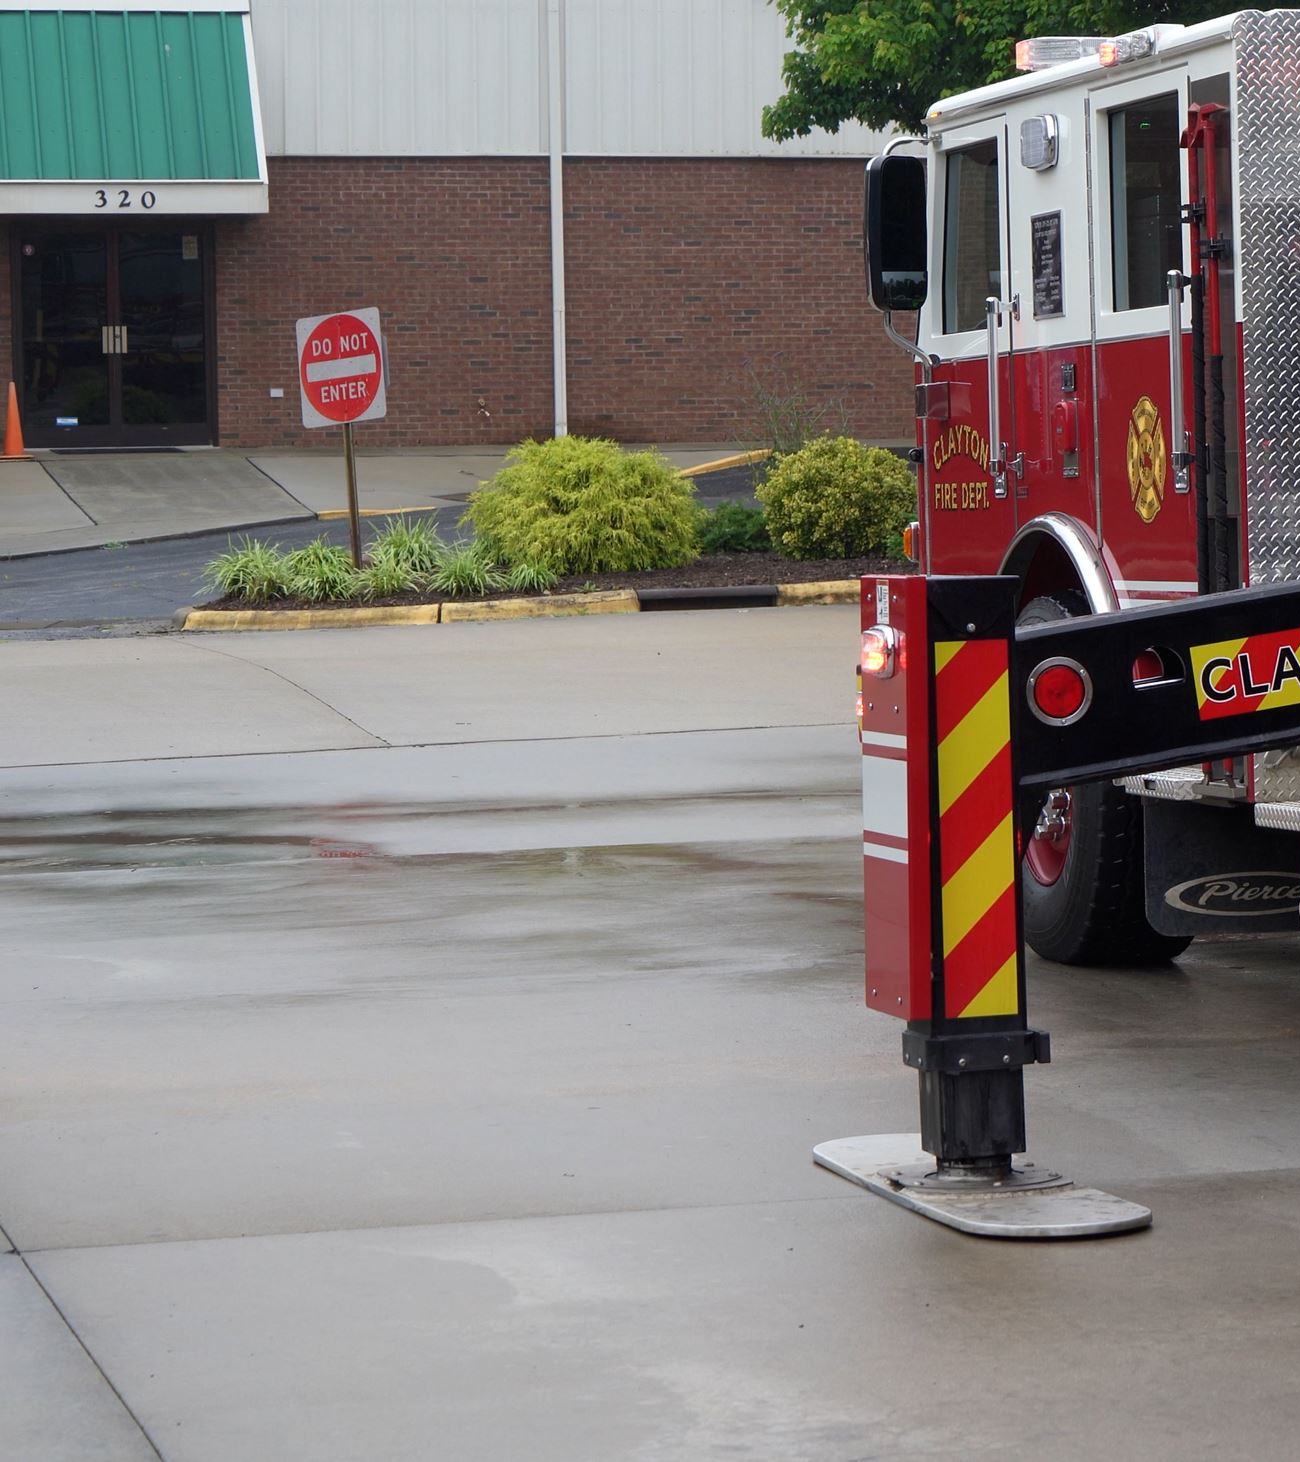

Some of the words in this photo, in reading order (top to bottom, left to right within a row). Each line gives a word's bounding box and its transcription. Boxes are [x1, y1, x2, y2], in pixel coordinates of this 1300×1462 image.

[95, 190, 156, 209] 320
[312, 338, 332, 356] DO
[340, 332, 368, 353] NOT
[321, 381, 366, 403] ENTER
[933, 424, 989, 471] CLAYTON
[935, 483, 957, 509] FIRE
[961, 482, 990, 509] DEPT.
